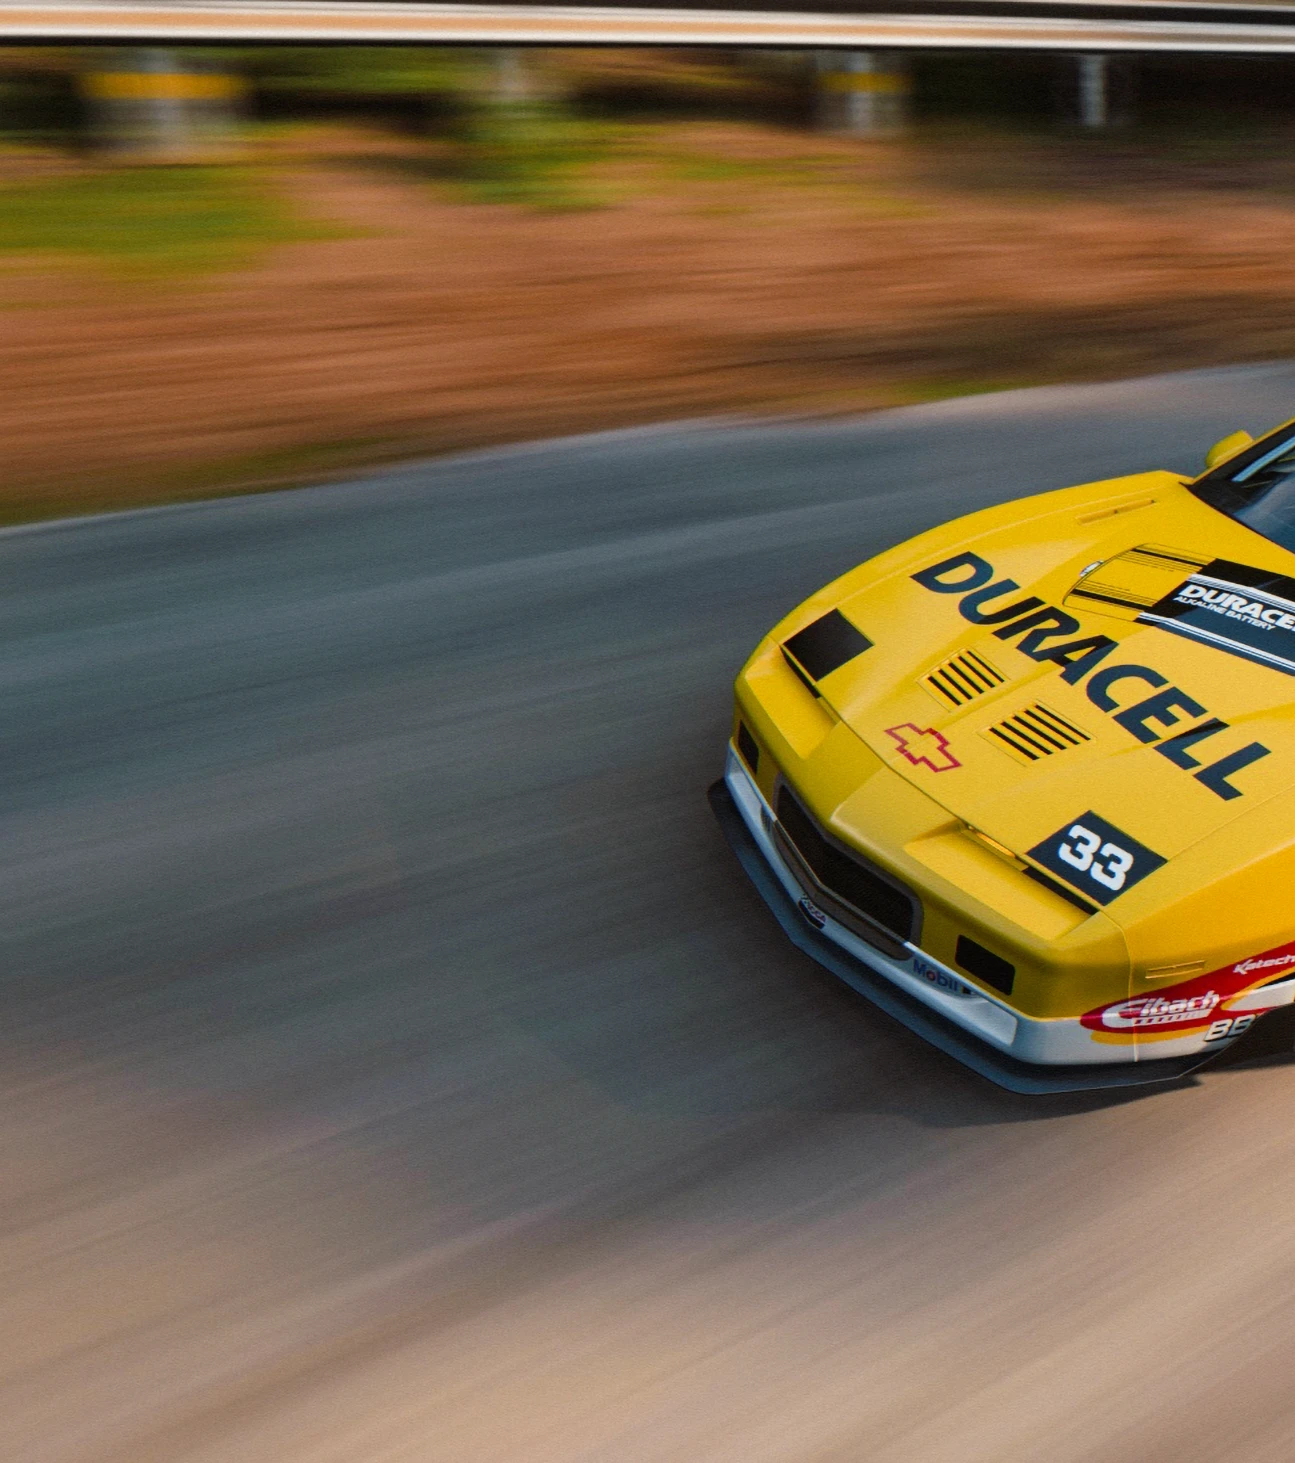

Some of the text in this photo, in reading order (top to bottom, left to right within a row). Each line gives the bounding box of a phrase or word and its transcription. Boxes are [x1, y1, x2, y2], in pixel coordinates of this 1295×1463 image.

[1173, 595, 1278, 632] ALKALINE BATTERY
[910, 551, 1272, 801] DURACELL
[1057, 823, 1135, 891] 33
[912, 958, 959, 992] Mobil
[1102, 989, 1221, 1029] Eibach
[1204, 1013, 1261, 1042] BB
